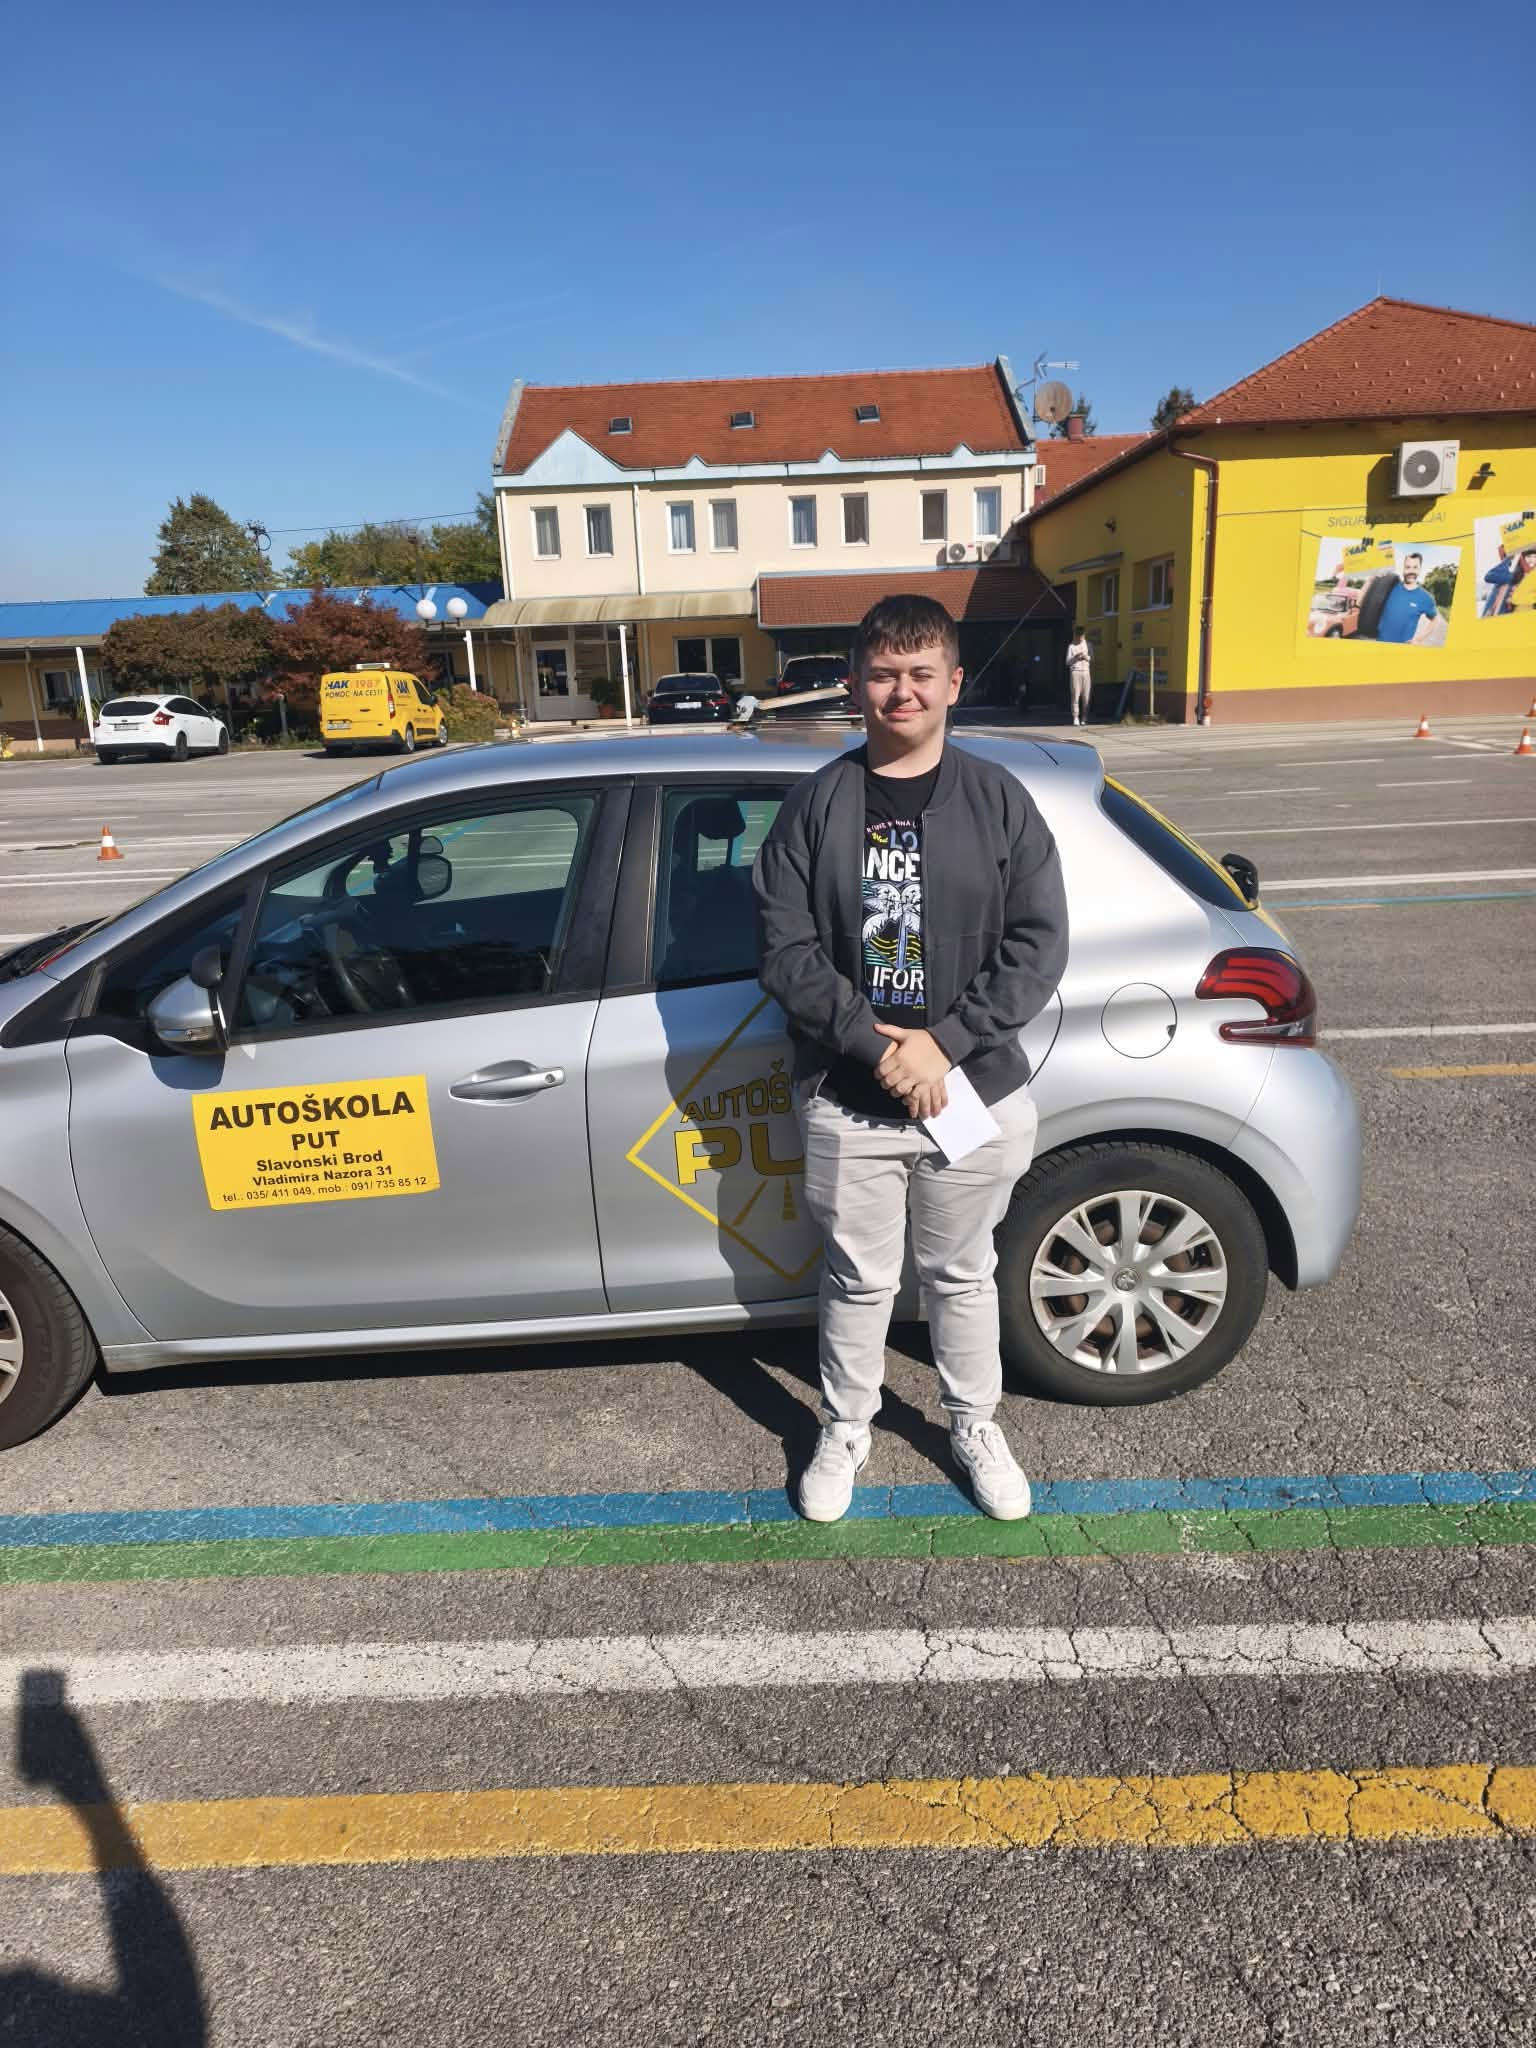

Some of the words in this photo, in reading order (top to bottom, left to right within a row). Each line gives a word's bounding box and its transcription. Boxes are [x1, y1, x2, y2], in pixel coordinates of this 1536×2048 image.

[862, 847, 921, 881] NCE
[868, 966, 925, 991] IFOR
[680, 1058, 794, 1124] AUTOŠ
[210, 1092, 415, 1131] AUTOŠKOLA
[291, 1131, 340, 1150] PUT
[256, 1154, 338, 1172] Slavonski
[343, 1149, 384, 1166] Brod
[246, 1190, 269, 1200] 035/
[271, 1188, 290, 1198] 411
[351, 1181, 374, 1191] 091/
[375, 1179, 396, 1189] 735
[398, 1177, 412, 1187] 85
[413, 1176, 428, 1186] 12
[252, 1173, 320, 1187] Vladimira
[323, 1169, 373, 1182] Nazora
[376, 1165, 393, 1176] 31
